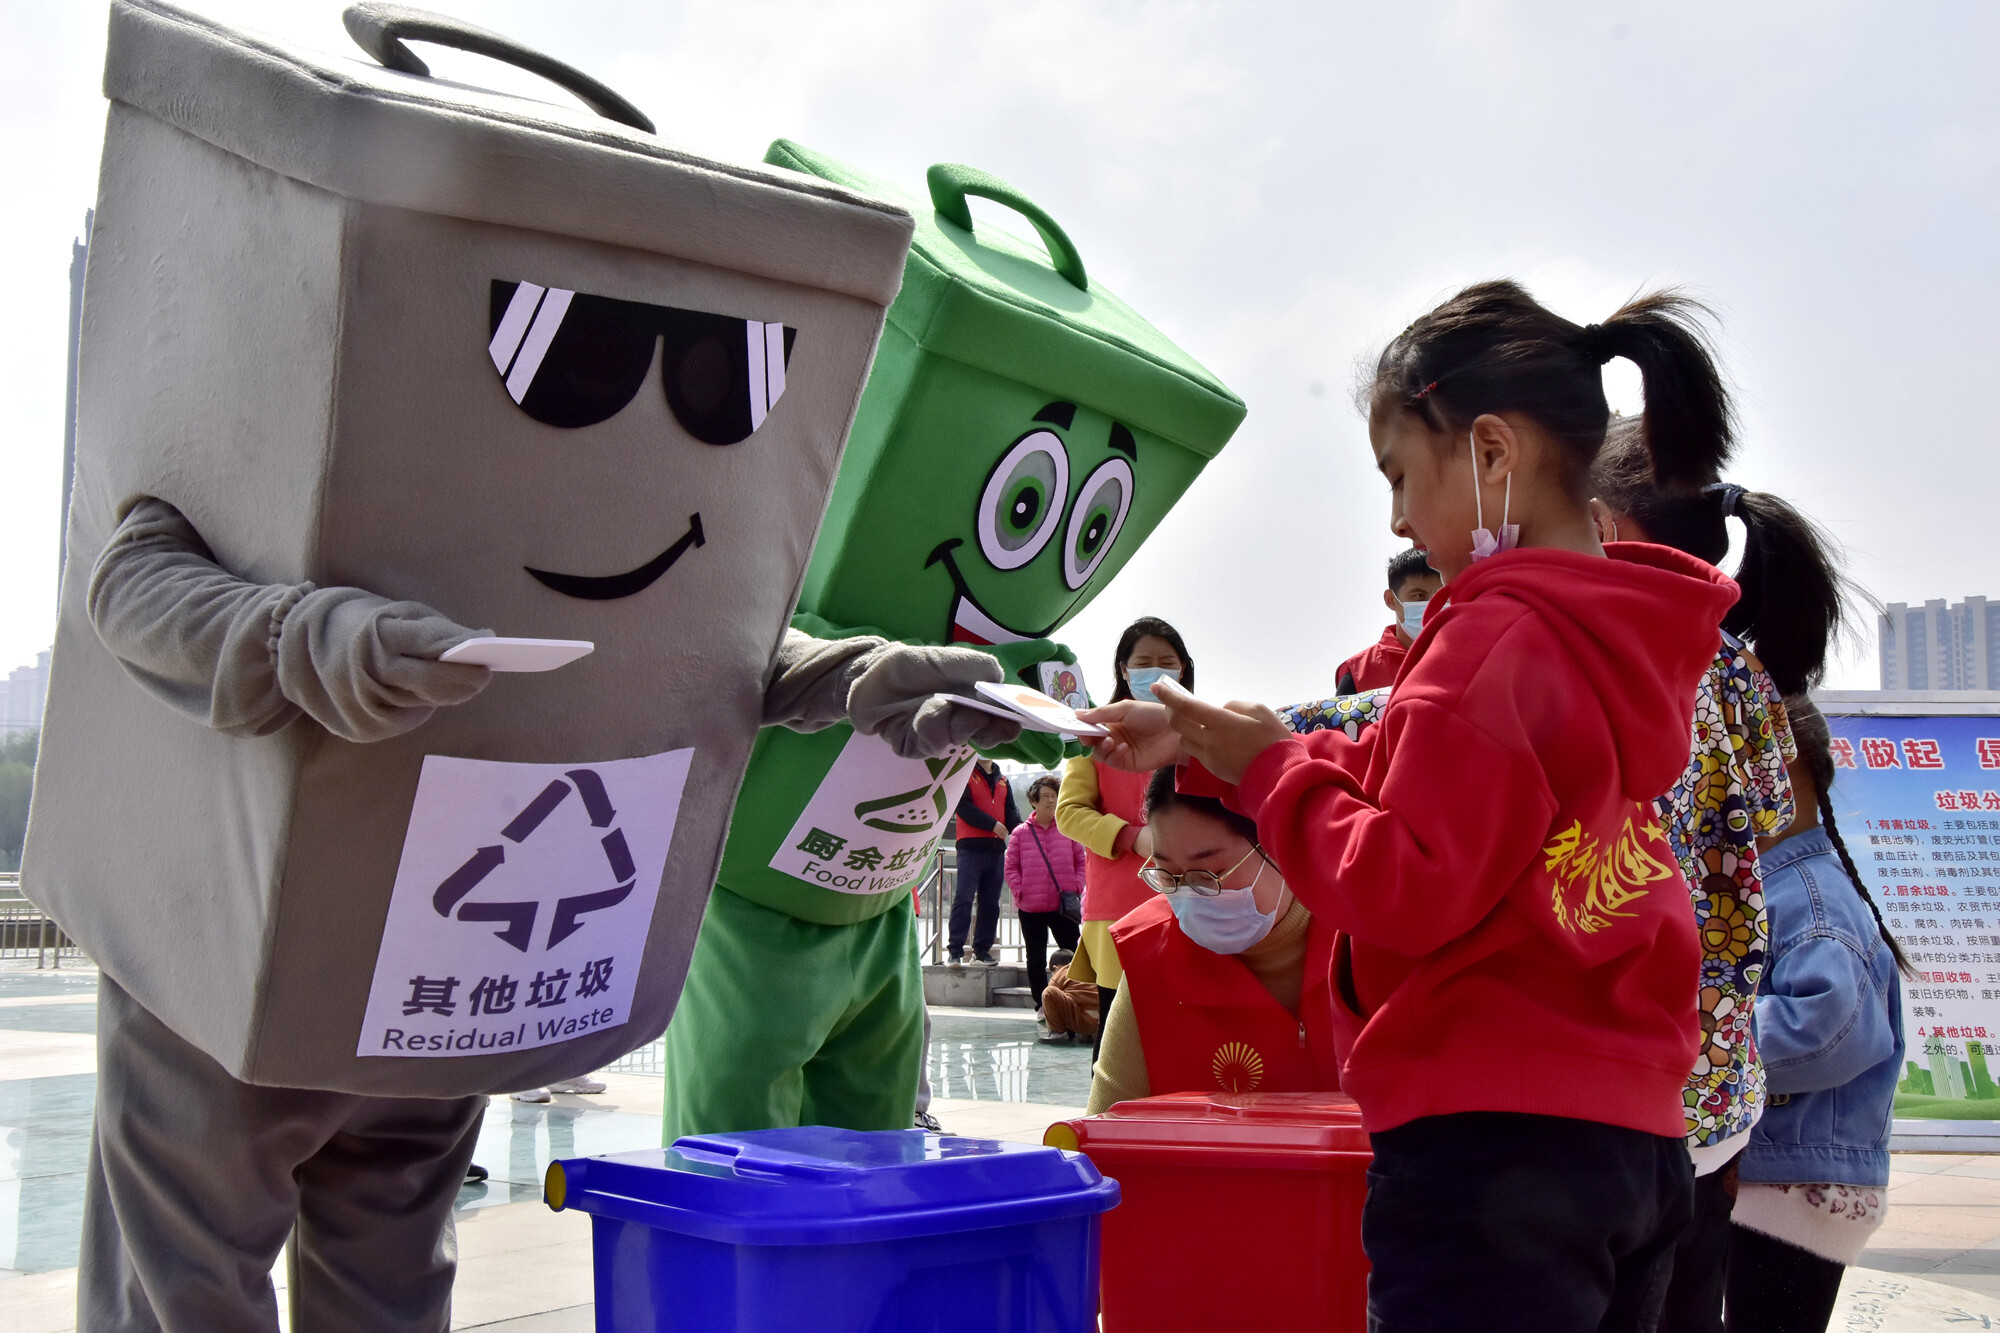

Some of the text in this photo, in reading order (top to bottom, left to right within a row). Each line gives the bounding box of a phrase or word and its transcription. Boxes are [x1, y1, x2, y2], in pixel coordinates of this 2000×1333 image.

[1829, 739, 1943, 768] 我做起
[1936, 791, 2000, 810] 垃圾分
[796, 827, 938, 872] 厨余垃圾
[801, 861, 915, 891] Food Waste
[1882, 885, 2000, 897] 2.厨余垃圾。主要包
[402, 956, 614, 1017] 其他垃圾
[1912, 1006, 1943, 1017] 装等。
[382, 1007, 613, 1050] Residual Waste
[1918, 1026, 1995, 1038] 4.其他垃圾。
